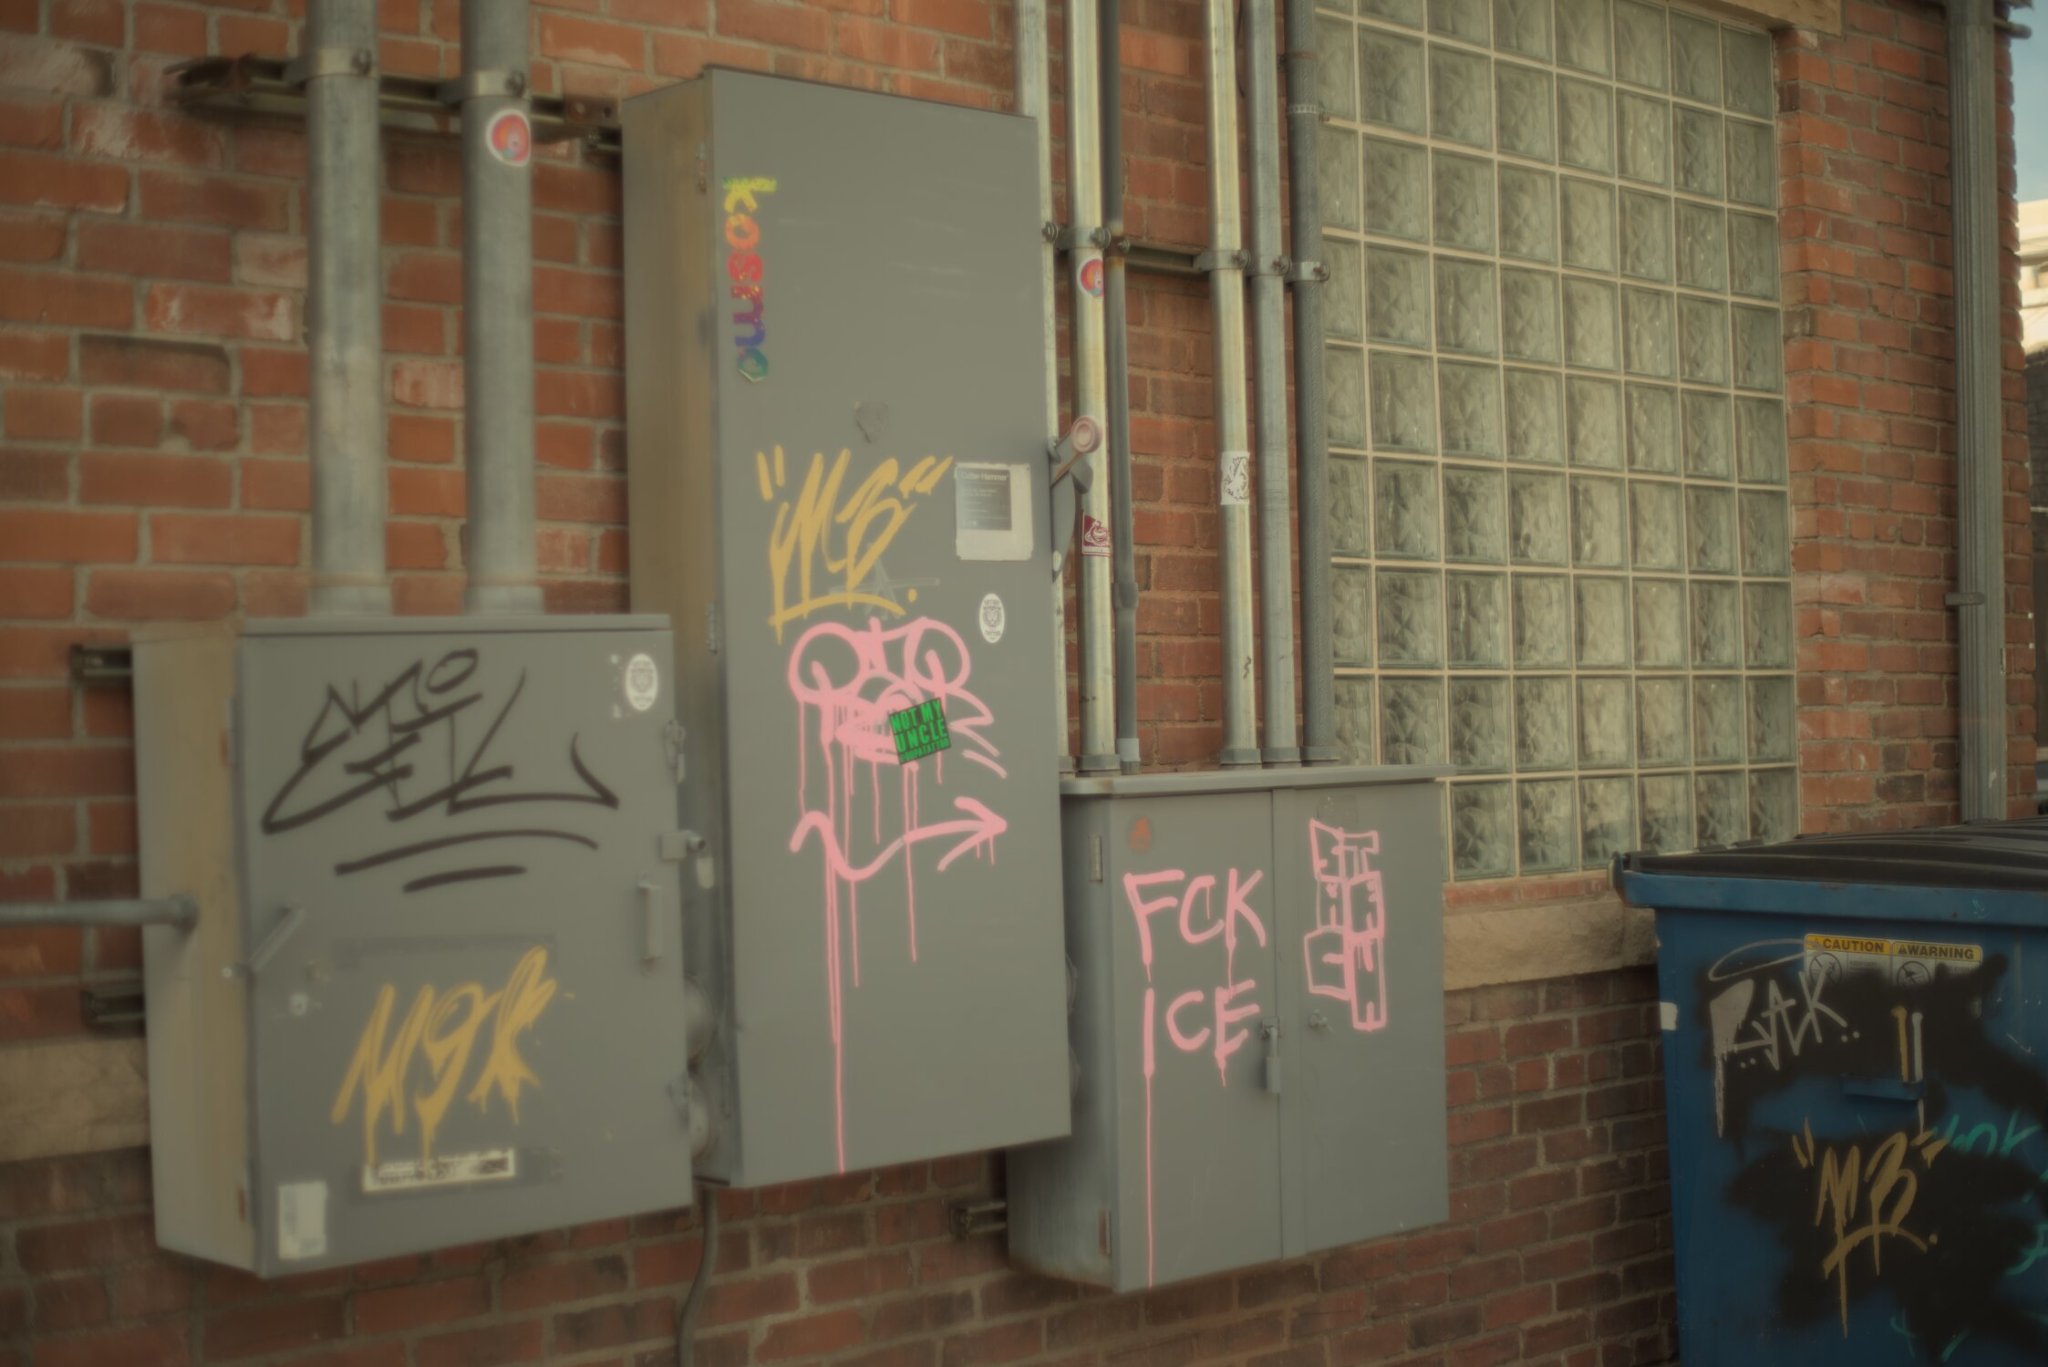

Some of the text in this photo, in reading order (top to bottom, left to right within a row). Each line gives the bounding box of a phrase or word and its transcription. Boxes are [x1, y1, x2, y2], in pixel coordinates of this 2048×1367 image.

[891, 700, 942, 733] NOT MY
[895, 720, 947, 752] UNCLE
[1123, 867, 1267, 967] FCK
[1823, 938, 1885, 953] CAUTION
[1906, 946, 1975, 960] WARNING
[1143, 979, 1261, 1078] ICE
